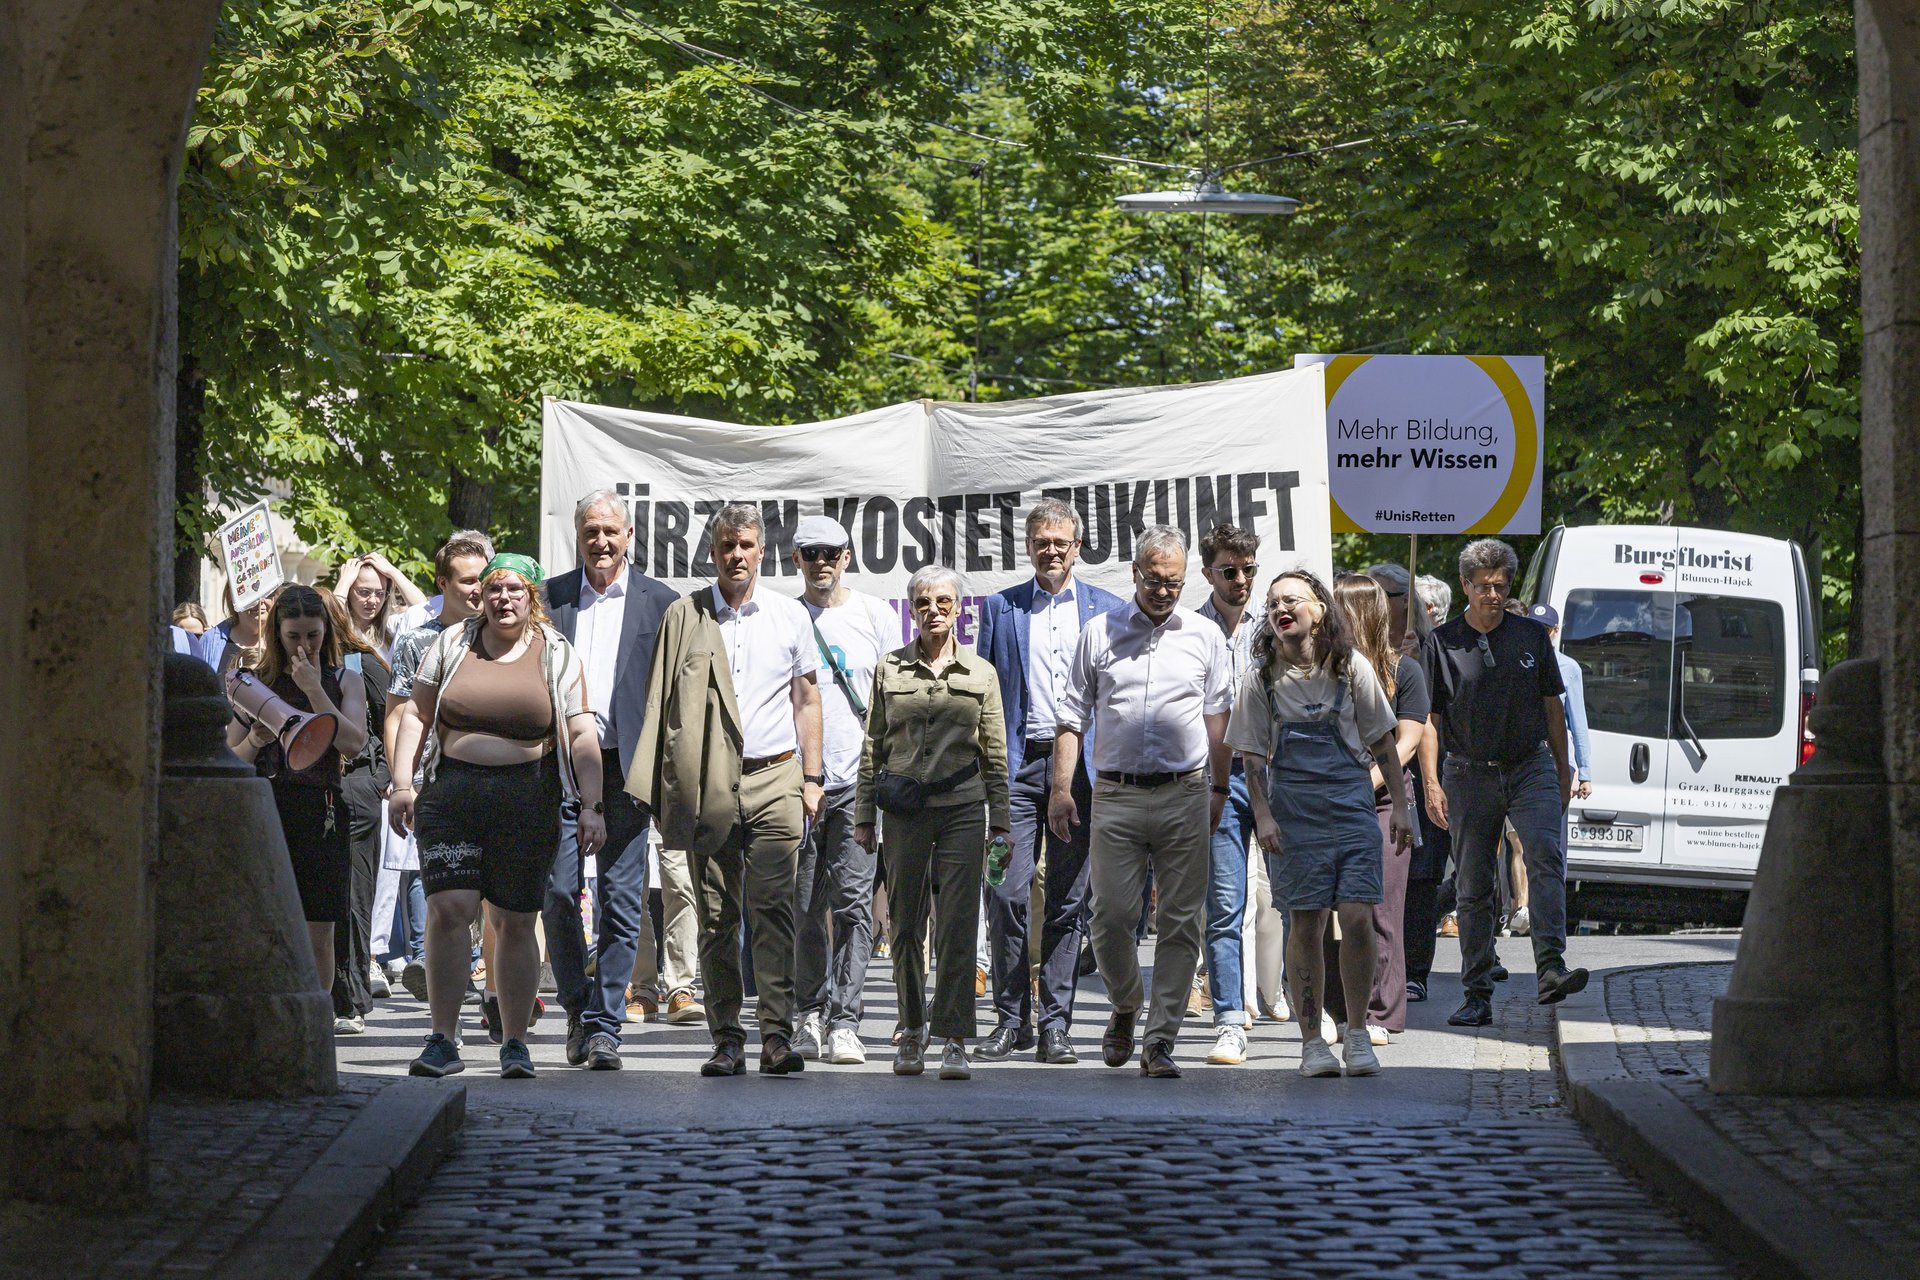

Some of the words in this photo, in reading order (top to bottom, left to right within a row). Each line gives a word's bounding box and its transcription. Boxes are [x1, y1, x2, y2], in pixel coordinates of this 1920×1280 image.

[1337, 418, 1398, 440] Mehr
[1407, 418, 1498, 447] Bildung,
[1337, 447, 1401, 468] mehr
[1410, 448, 1497, 469] Wissen
[576, 483, 798, 578] ÜRZN
[823, 491, 1020, 575] KOSTET
[1042, 470, 1300, 565] UKUNFT
[1375, 510, 1456, 522] #UnisRetten
[227, 518, 255, 545] MEINE
[232, 557, 249, 575] IST
[1614, 544, 1753, 572] Burgflorist
[1681, 573, 1753, 587] Blumen-Hajek
[1734, 774, 1782, 784] RENAULT
[1678, 782, 1709, 793] Graz,
[1714, 784, 1772, 796] Burggasse
[1672, 798, 1699, 806] TEL.
[1704, 800, 1728, 808] 0316
[1571, 826, 1578, 839] G
[1589, 827, 1613, 841] 993
[1617, 828, 1633, 842] DR
[1697, 829, 1722, 837] online
[1724, 830, 1760, 839] bestellen
